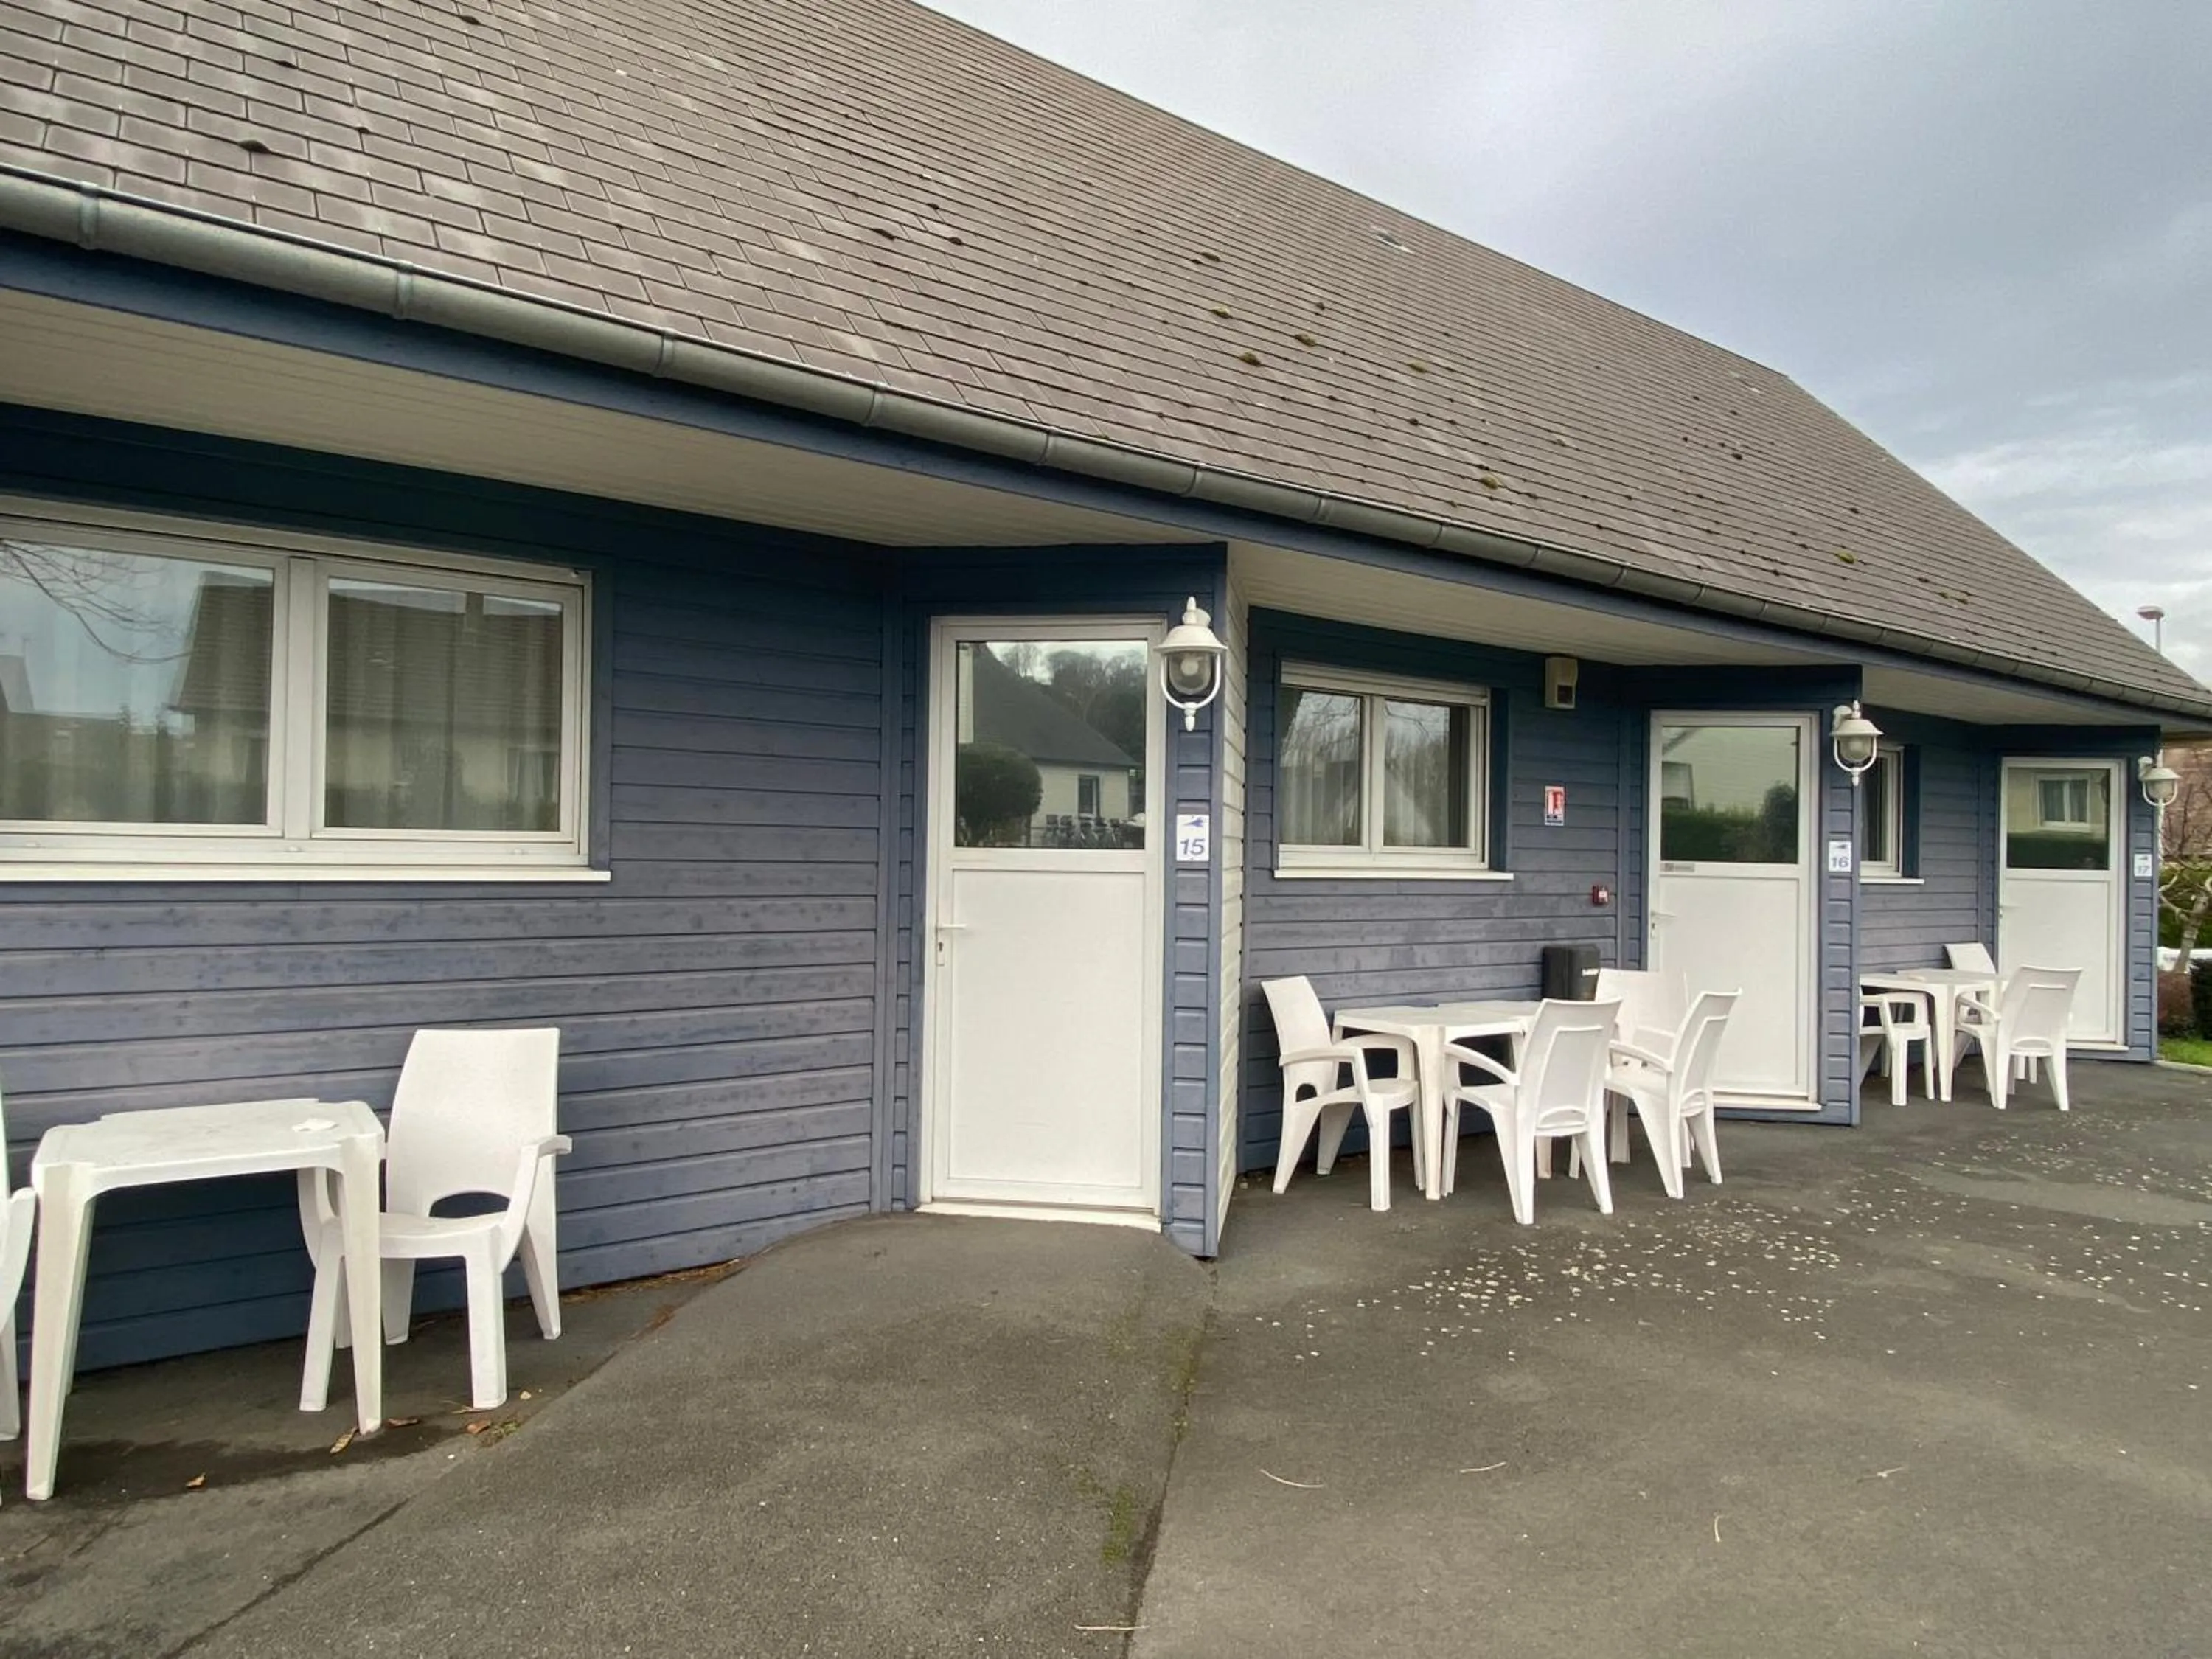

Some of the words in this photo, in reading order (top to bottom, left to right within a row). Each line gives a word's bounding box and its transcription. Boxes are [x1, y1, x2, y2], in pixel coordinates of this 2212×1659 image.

[1180, 838, 1205, 855] 15
[1832, 856, 1849, 868] 16
[2138, 865, 2150, 874] 17
